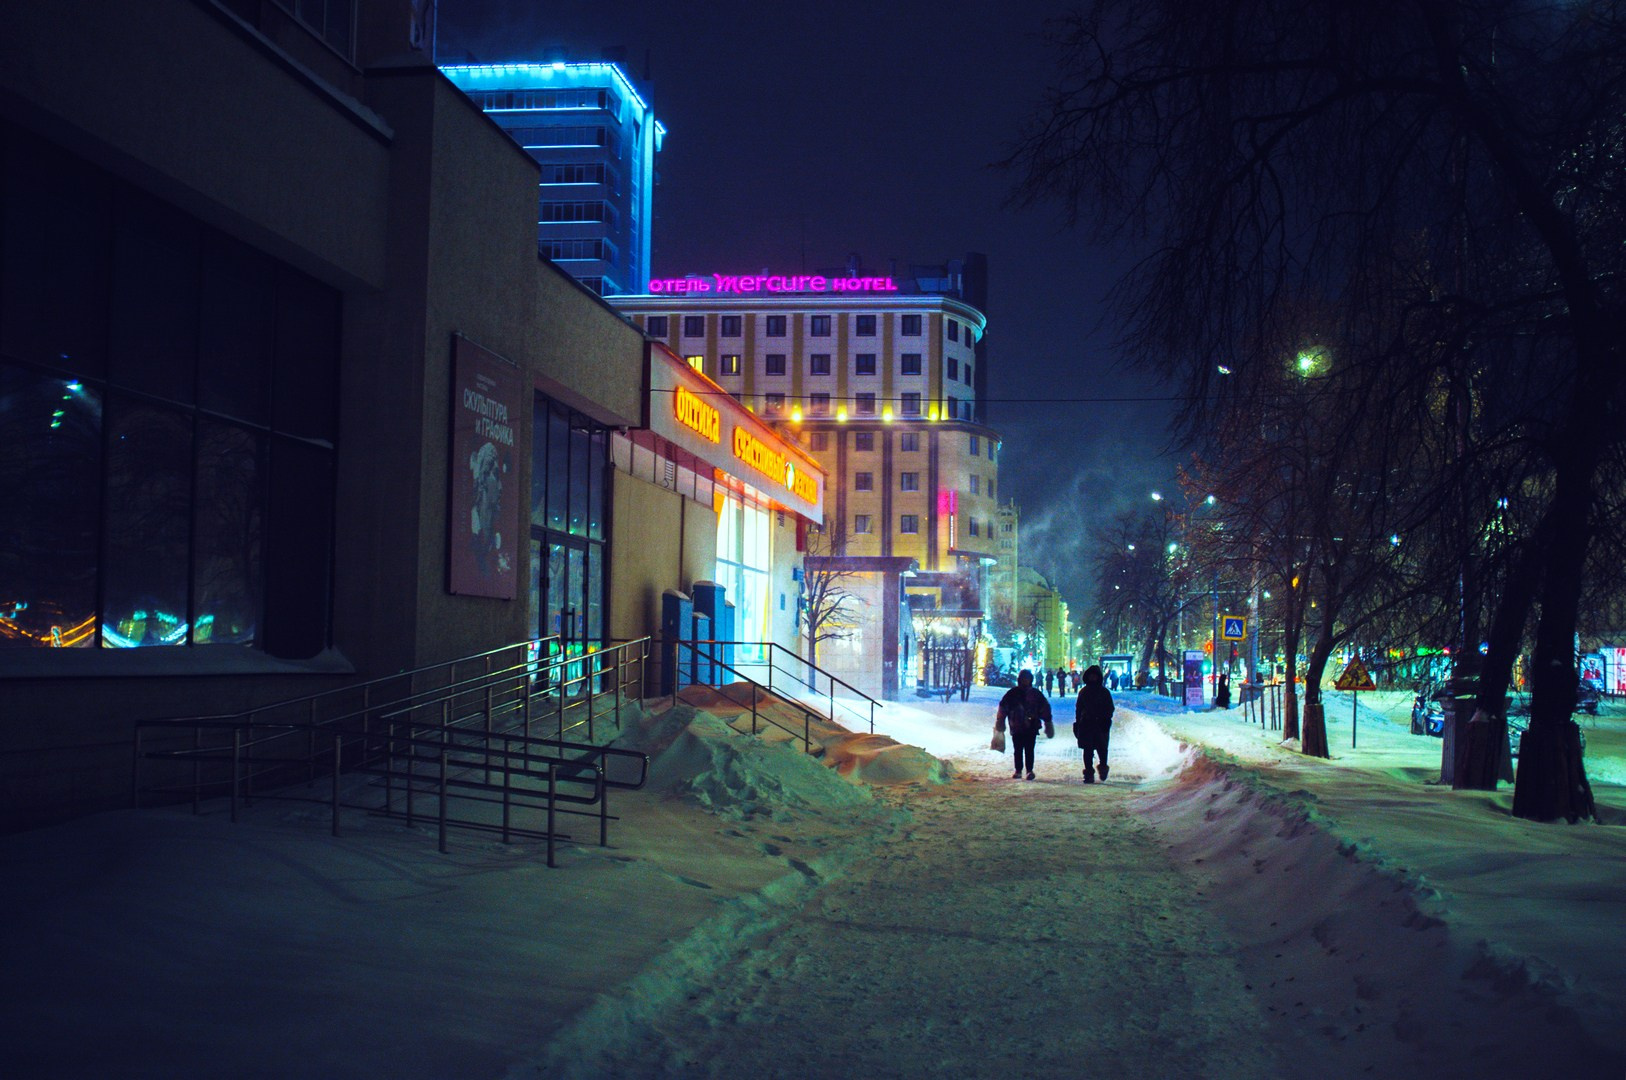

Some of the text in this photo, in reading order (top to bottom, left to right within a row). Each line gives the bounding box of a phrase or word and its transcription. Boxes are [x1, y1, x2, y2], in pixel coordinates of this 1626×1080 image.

[649, 278, 711, 293] ОТЕЛЬ
[832, 277, 898, 292] HOTEL
[463, 387, 508, 425] СКУЛЬПТУРА
[481, 417, 514, 447] ГРАФИКА
